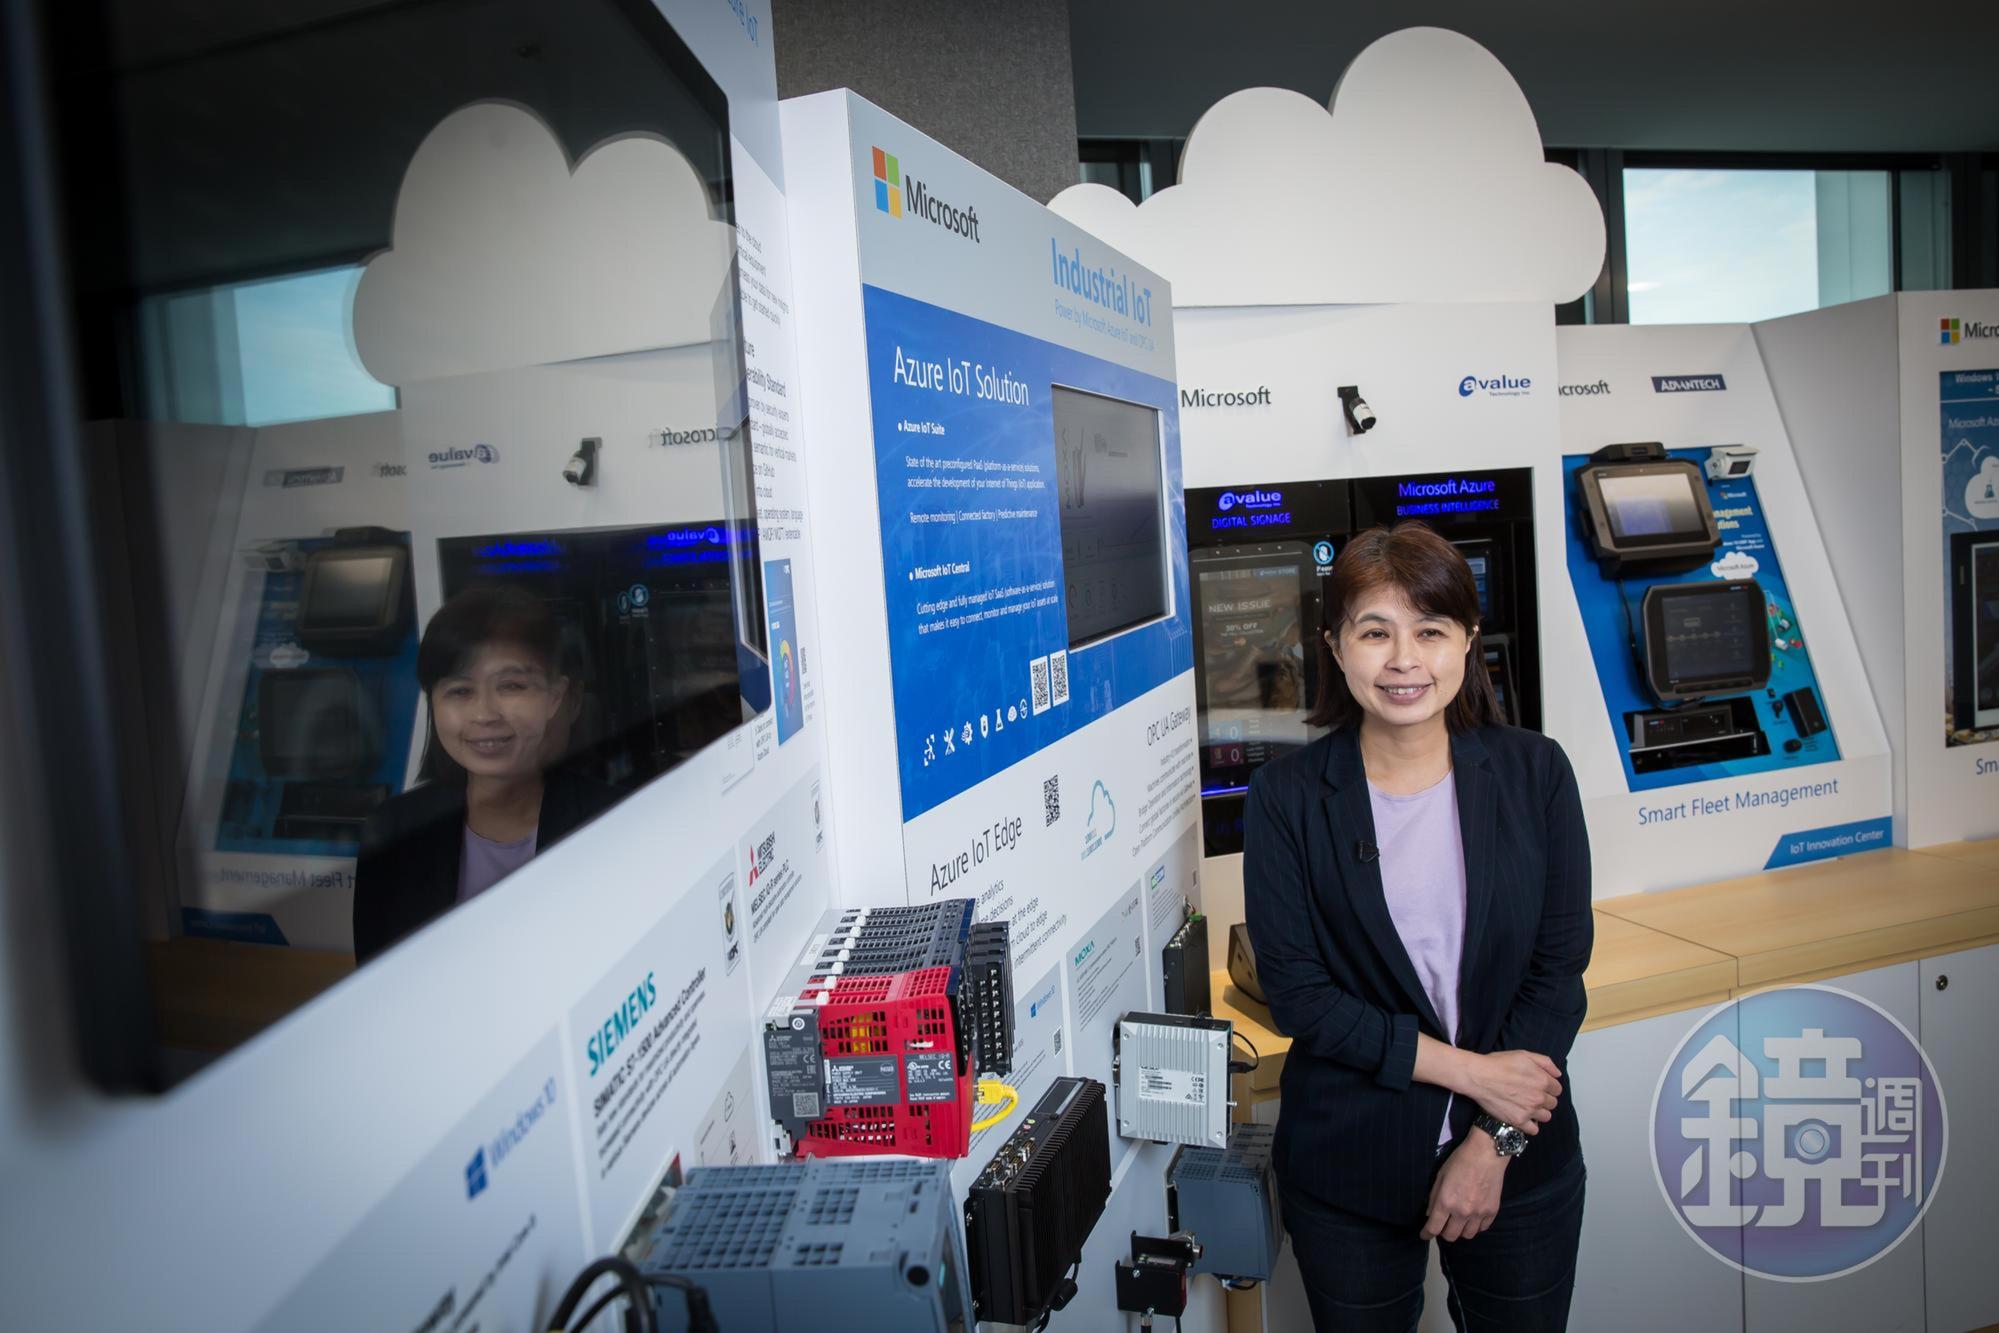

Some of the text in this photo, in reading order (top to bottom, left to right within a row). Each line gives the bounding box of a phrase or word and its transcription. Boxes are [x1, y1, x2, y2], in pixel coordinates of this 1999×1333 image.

[905, 174, 980, 243] Microsoft
[1051, 238, 1152, 328] Industrial IoT
[894, 346, 1030, 406] Azure IoT Solution
[1661, 379, 1721, 391] ADVANTECH
[1180, 386, 1272, 408] Microsoft
[904, 420, 945, 435] Azure IoT Suite
[905, 456, 918, 468] State
[925, 457, 934, 468] the
[907, 478, 932, 488] accelerate
[932, 476, 941, 488] the
[942, 476, 970, 491] development
[1397, 478, 1496, 498] Microsoft Azure
[910, 512, 929, 523] Remote
[1396, 499, 1500, 517] BUSINESS INTELLIGENCE
[1211, 512, 1291, 530] DIGITAL SIGNAGE
[914, 561, 970, 579] Microsoft IoT Central
[917, 602, 935, 615] Cutting
[936, 600, 949, 613] edge
[949, 597, 958, 609] and
[958, 595, 968, 609] fully
[968, 593, 987, 607] managed
[1208, 599, 1272, 614] NEW ISSUE
[918, 623, 929, 635] that
[929, 620, 945, 633] makes
[950, 617, 960, 630] easy
[1147, 721, 1160, 747] OPC
[1170, 706, 1191, 731] Gateway
[1638, 778, 1839, 825] Smart Fleet Management
[1790, 829, 1885, 855] IoT Innovation Center
[930, 816, 1023, 897] Azure IoT Edge
[981, 880, 1004, 905] analytics
[991, 896, 1014, 921] decisions
[1018, 906, 1028, 921] the
[1027, 897, 1039, 914] edge
[1016, 926, 1030, 945] cloud
[1035, 910, 1048, 928] edge
[1074, 940, 1095, 967] MOXA
[587, 970, 657, 1077] SIEMENS
